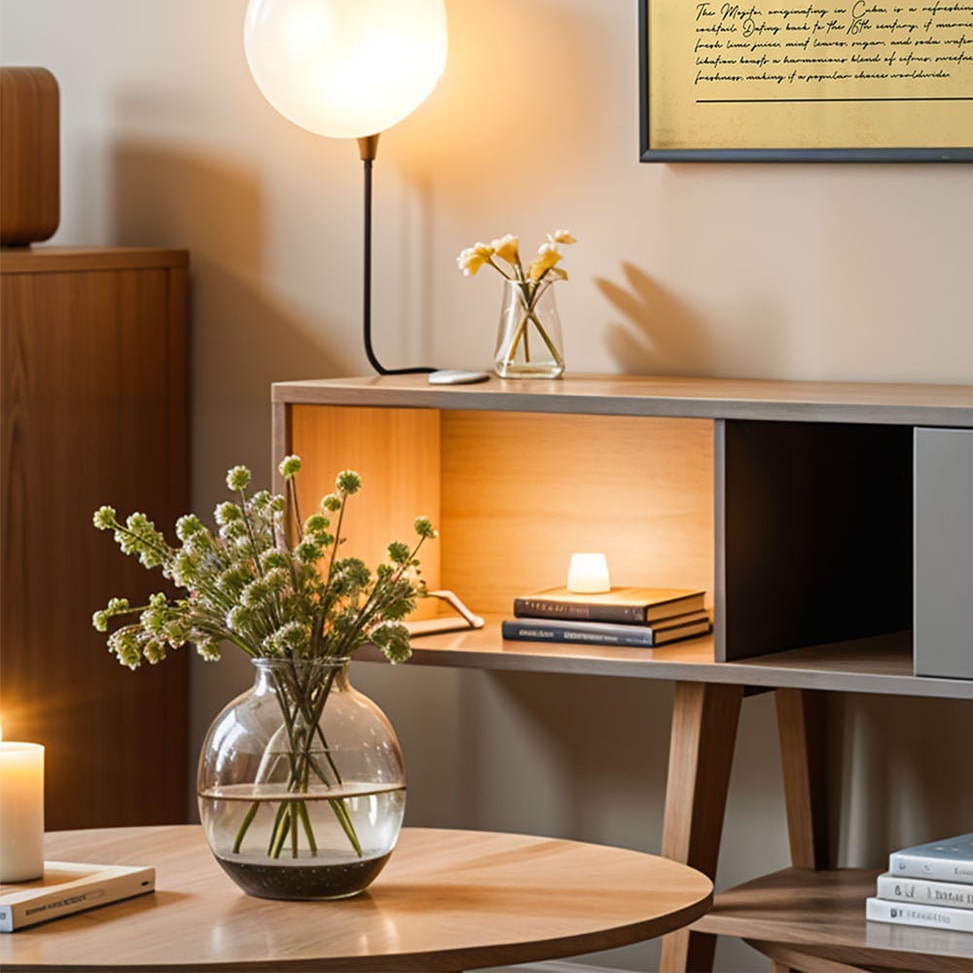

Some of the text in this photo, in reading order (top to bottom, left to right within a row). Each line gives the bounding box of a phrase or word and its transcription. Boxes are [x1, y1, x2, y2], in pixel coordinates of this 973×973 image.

[696, 3, 716, 21] The
[768, 5, 829, 19] originating
[893, 6, 903, 14] is
[742, 18, 781, 38] Dating
[786, 22, 810, 31] back
[812, 20, 825, 34] to
[826, 20, 845, 34] the
[846, 18, 872, 36] 16th
[923, 18, 933, 32] it
[694, 38, 723, 53] fresh
[726, 40, 751, 49] lime
[786, 37, 811, 50] mint
[890, 37, 912, 46] and
[914, 36, 941, 46] soda
[696, 54, 737, 68] libation
[740, 54, 769, 68] boasts
[783, 55, 848, 64] harmonious
[851, 54, 881, 63] blend
[884, 51, 896, 66] of
[746, 72, 785, 85] making
[788, 69, 797, 83] it
[806, 71, 852, 83] popular
[854, 70, 889, 79] choice
